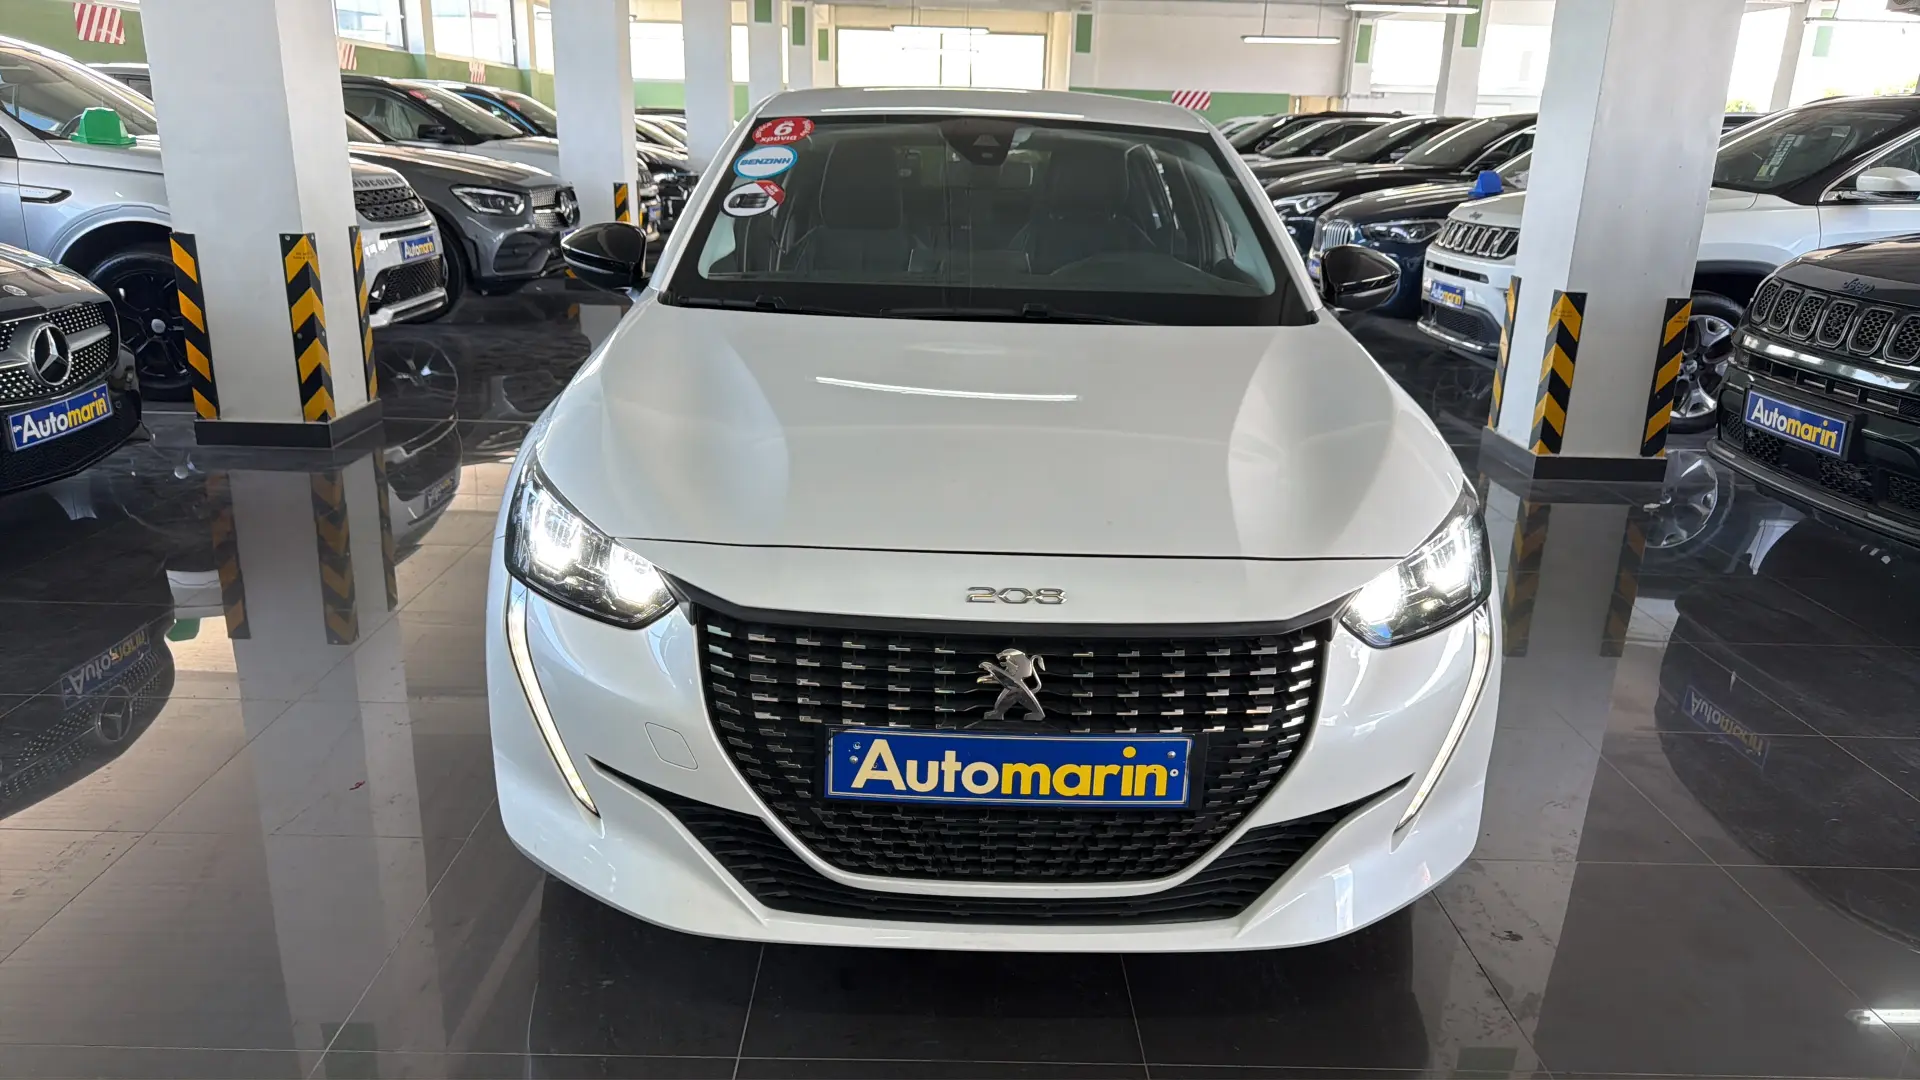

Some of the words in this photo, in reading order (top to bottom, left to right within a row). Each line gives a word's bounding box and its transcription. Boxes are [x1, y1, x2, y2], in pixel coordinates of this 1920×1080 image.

[774, 122, 795, 136] 6
[404, 236, 434, 259] Automarin
[1431, 282, 1462, 305] Automarin
[1842, 278, 1875, 295] Jeep
[22, 391, 107, 444] Automarin
[1751, 397, 1837, 449] Automarin
[965, 586, 1068, 604] 208
[850, 738, 1168, 796] Automarin
